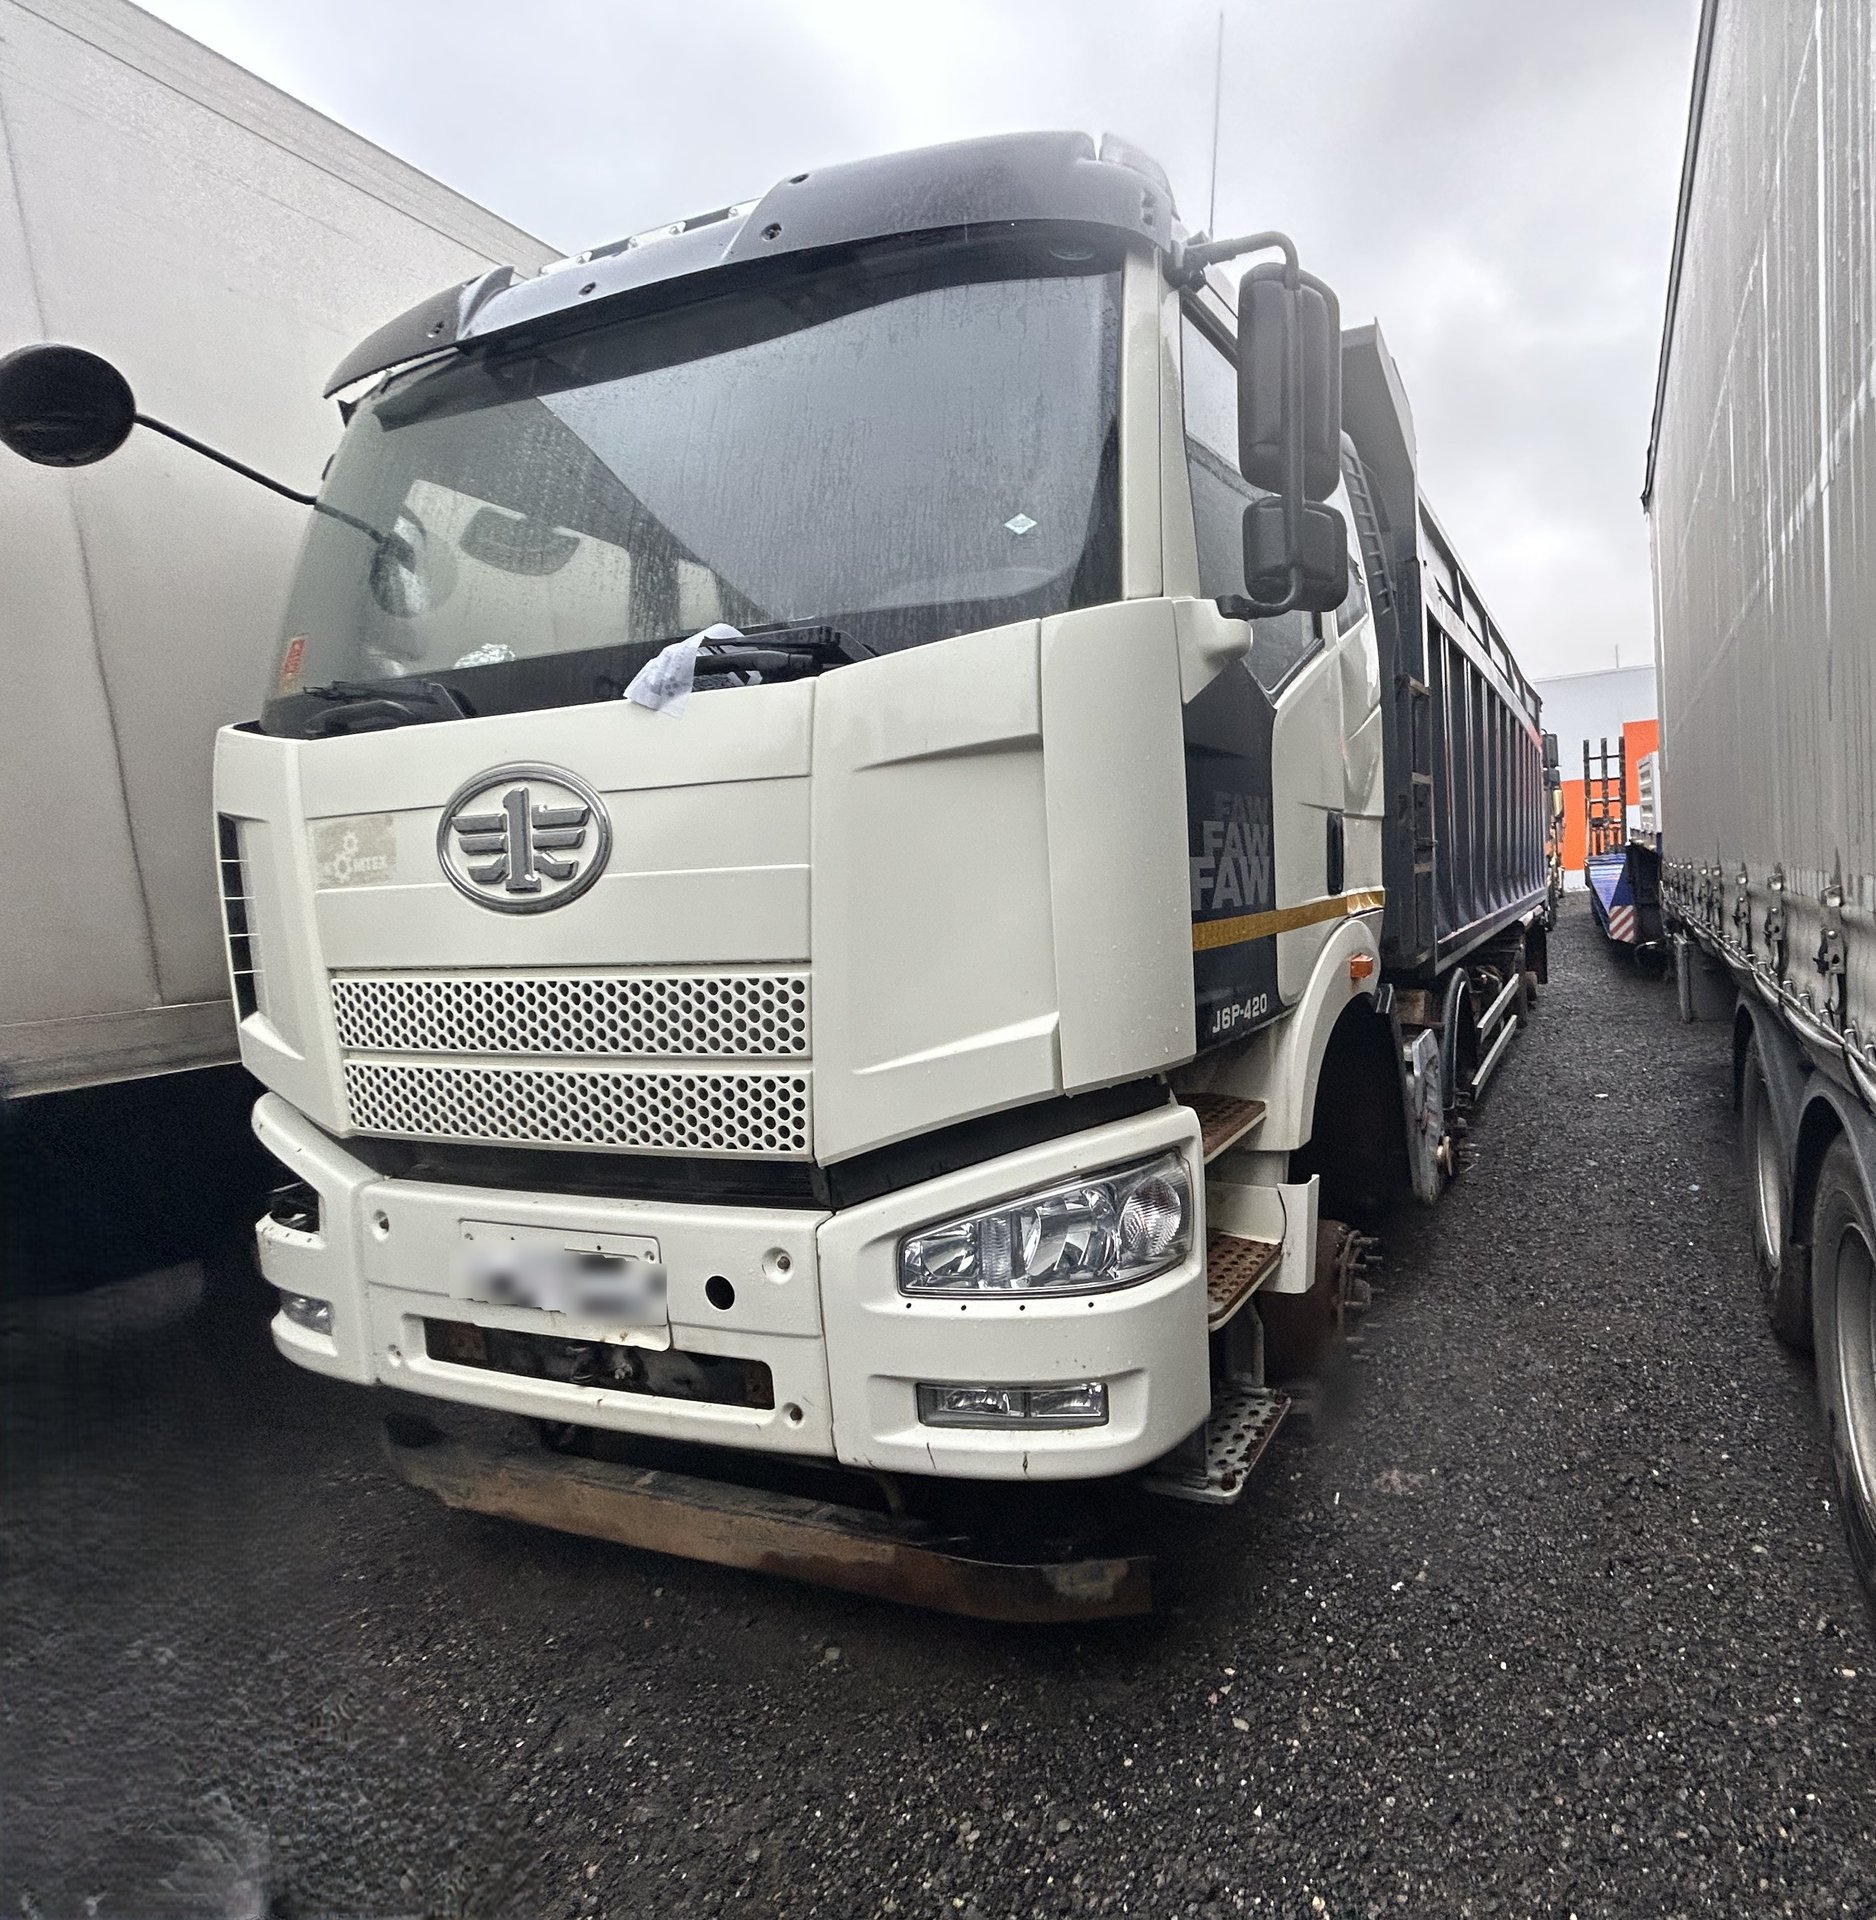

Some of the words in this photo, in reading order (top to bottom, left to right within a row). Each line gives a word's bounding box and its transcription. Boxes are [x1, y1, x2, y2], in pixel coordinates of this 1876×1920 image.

[1203, 820, 1269, 858] FAW
[1190, 856, 1271, 910] FAW
[1212, 993, 1267, 1034] J6P-420
